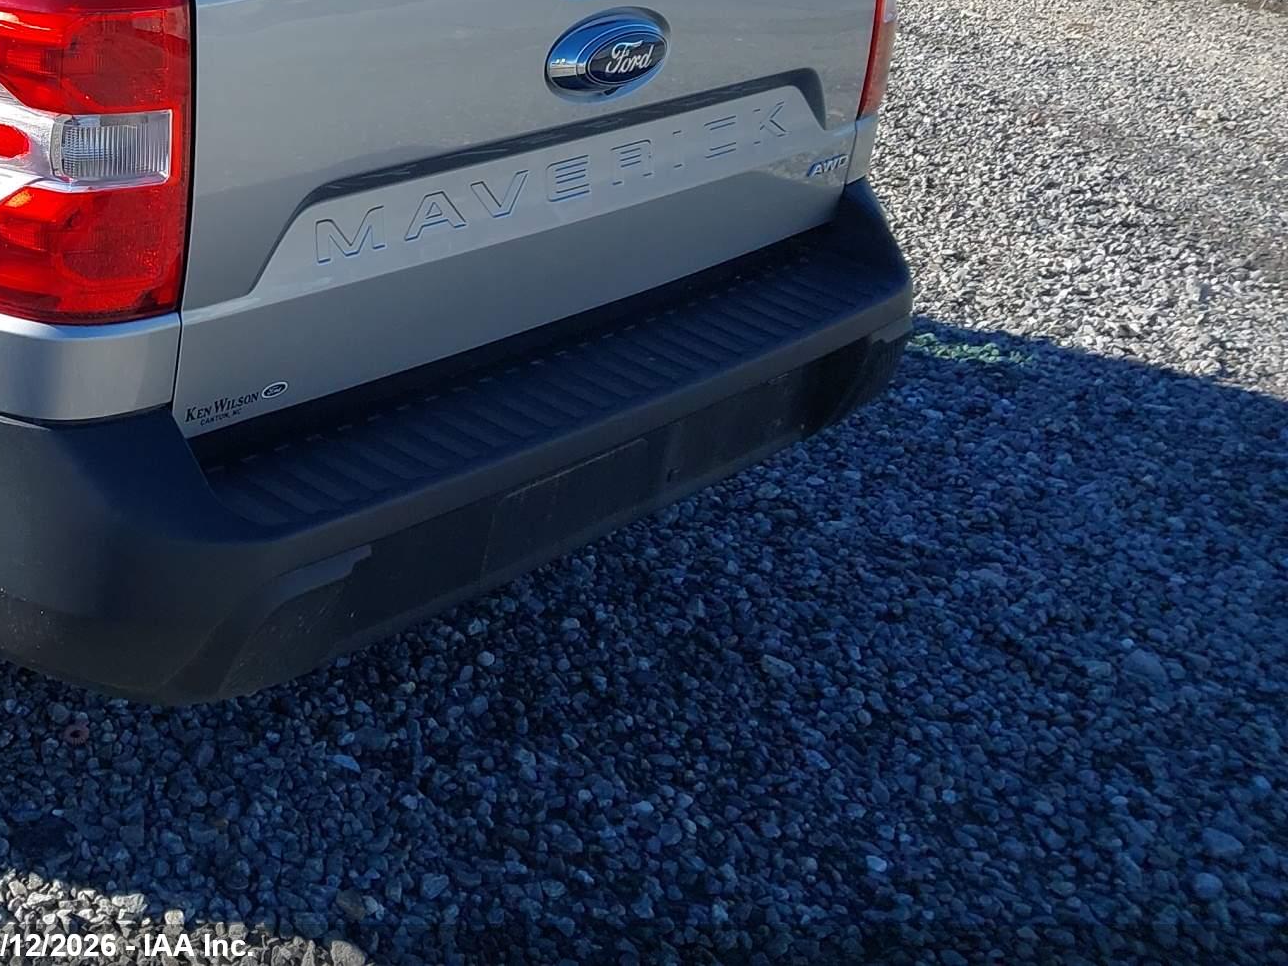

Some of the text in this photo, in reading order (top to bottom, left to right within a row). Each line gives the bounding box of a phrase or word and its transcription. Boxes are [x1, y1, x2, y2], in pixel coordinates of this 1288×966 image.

[605, 40, 655, 74] Ford
[807, 154, 849, 177] AWD
[315, 101, 791, 263] MAVERICK
[185, 405, 212, 423] KEN
[214, 392, 259, 413] WILSON
